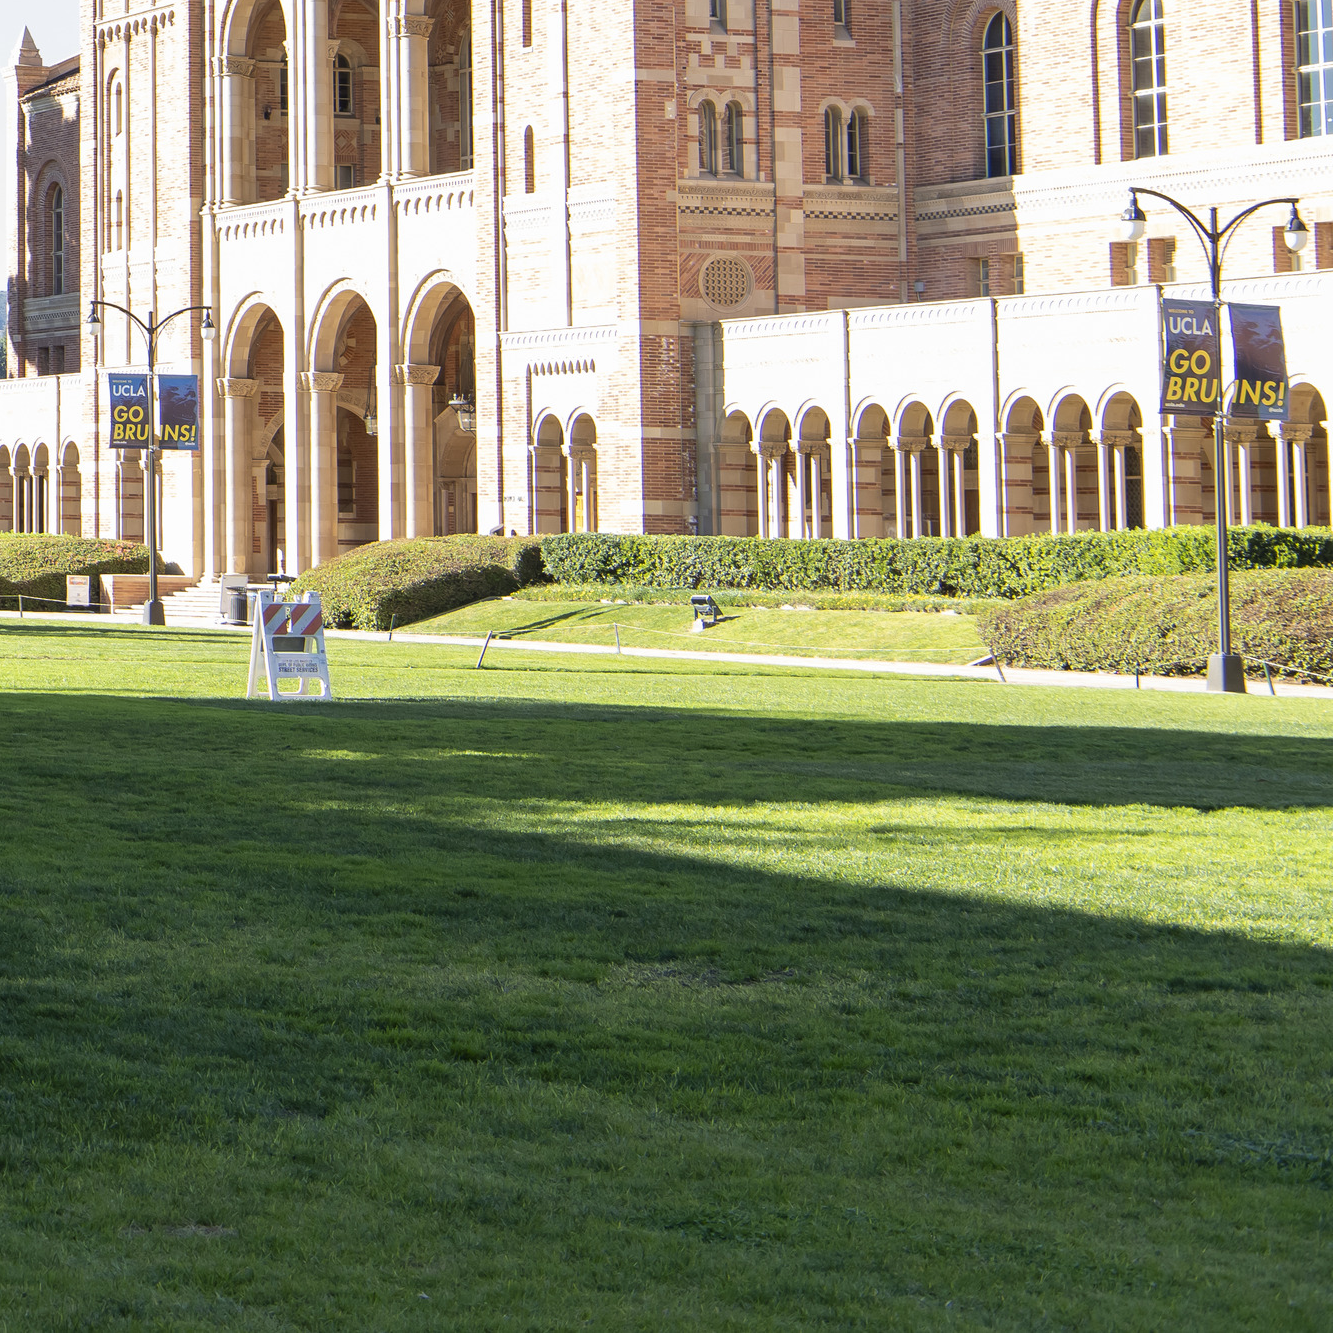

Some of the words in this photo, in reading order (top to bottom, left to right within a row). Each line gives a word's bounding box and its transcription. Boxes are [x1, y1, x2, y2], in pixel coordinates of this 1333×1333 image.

[1169, 316, 1213, 335] UCLA
[1169, 349, 1211, 375] GO
[113, 385, 146, 397] UCLA
[114, 406, 144, 422] GO
